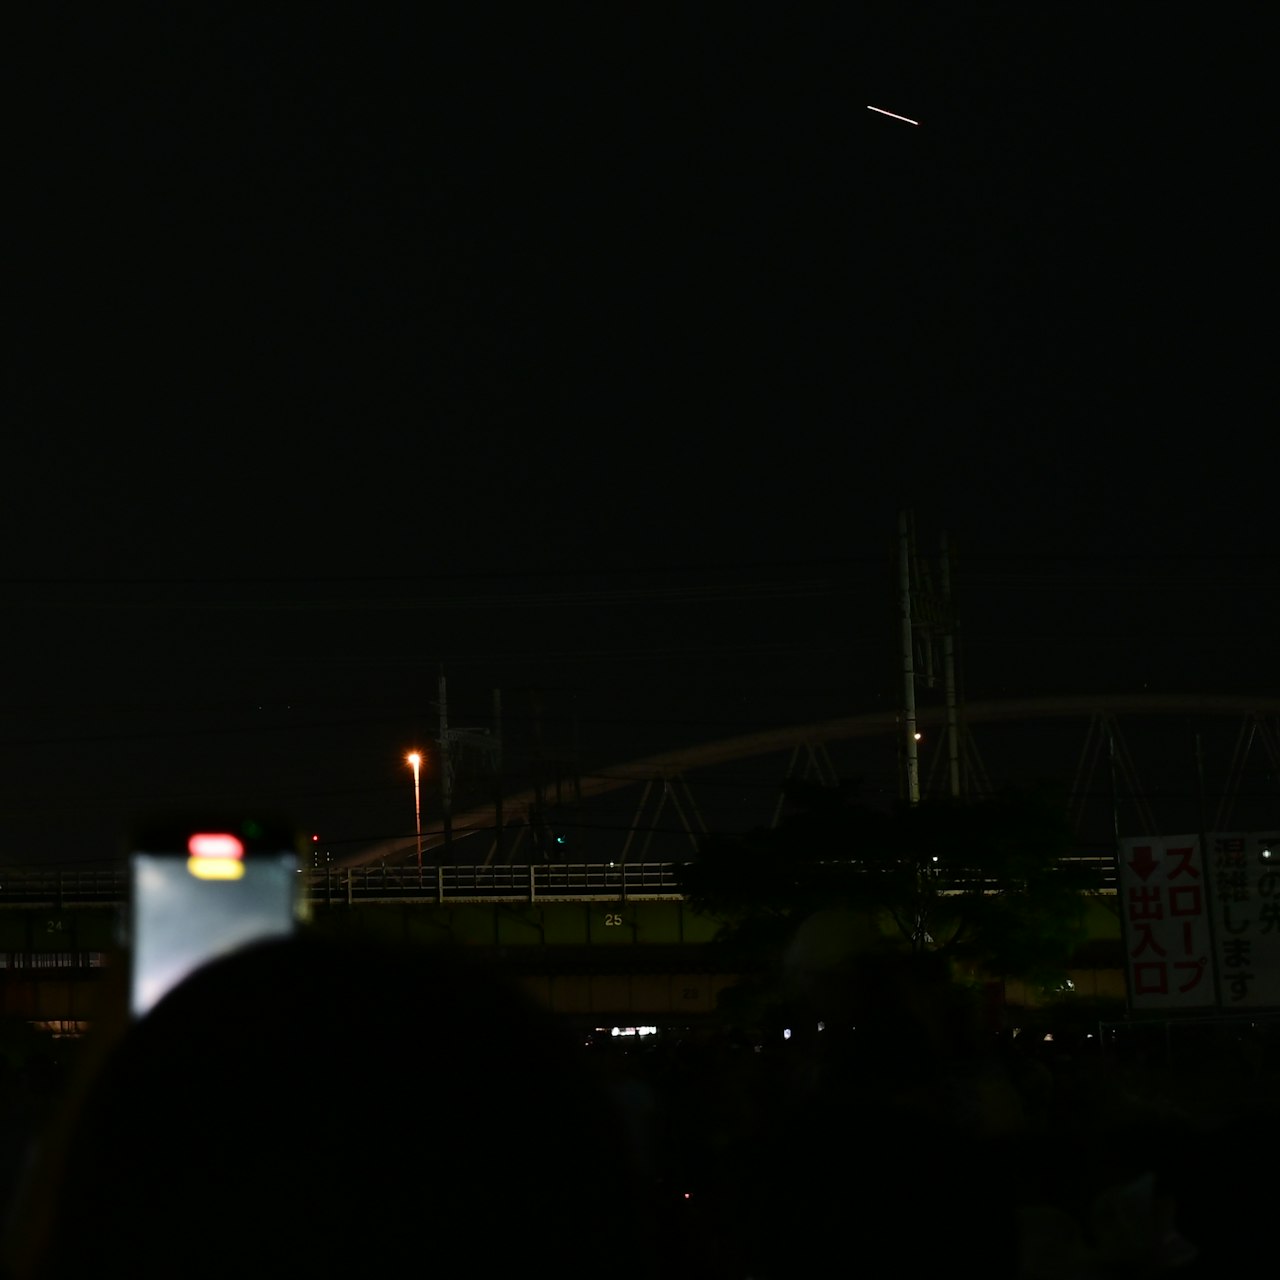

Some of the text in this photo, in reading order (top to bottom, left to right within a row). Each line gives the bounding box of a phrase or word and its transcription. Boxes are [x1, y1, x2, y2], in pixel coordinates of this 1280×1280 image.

[46, 920, 63, 933] 24
[604, 913, 623, 926] 25
[1128, 885, 1169, 995] 出入口
[1166, 846, 1208, 994] スロープ
[1214, 837, 1255, 1002] 混雑します
